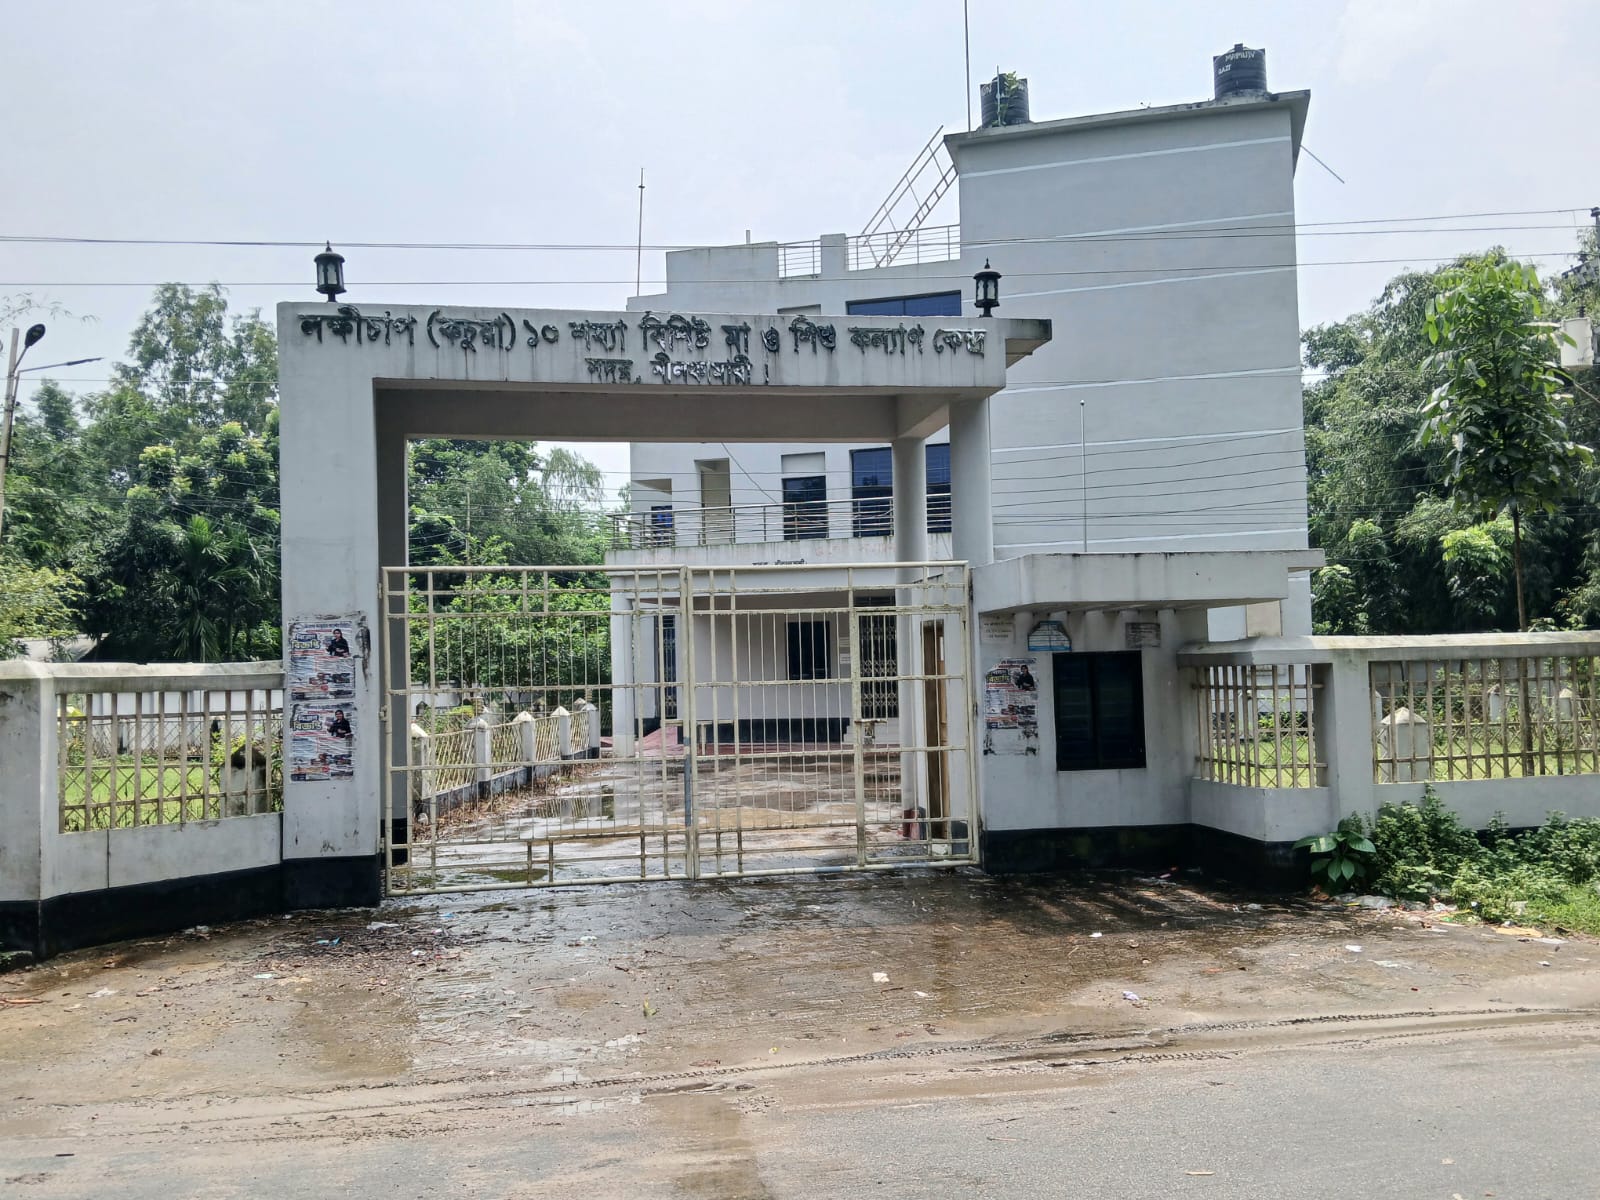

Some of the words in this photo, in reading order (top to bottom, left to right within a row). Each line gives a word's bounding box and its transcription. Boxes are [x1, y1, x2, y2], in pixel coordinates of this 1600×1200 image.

[522, 318, 560, 347] ১০
[568, 318, 628, 351] শয্যা
[639, 311, 711, 352] বিশিষ্ট
[721, 320, 751, 353] মা
[761, 326, 780, 353] ও
[788, 314, 837, 355] শিশু
[848, 322, 925, 355] কল্যাণ
[932, 327, 988, 358] কেন্দ্র
